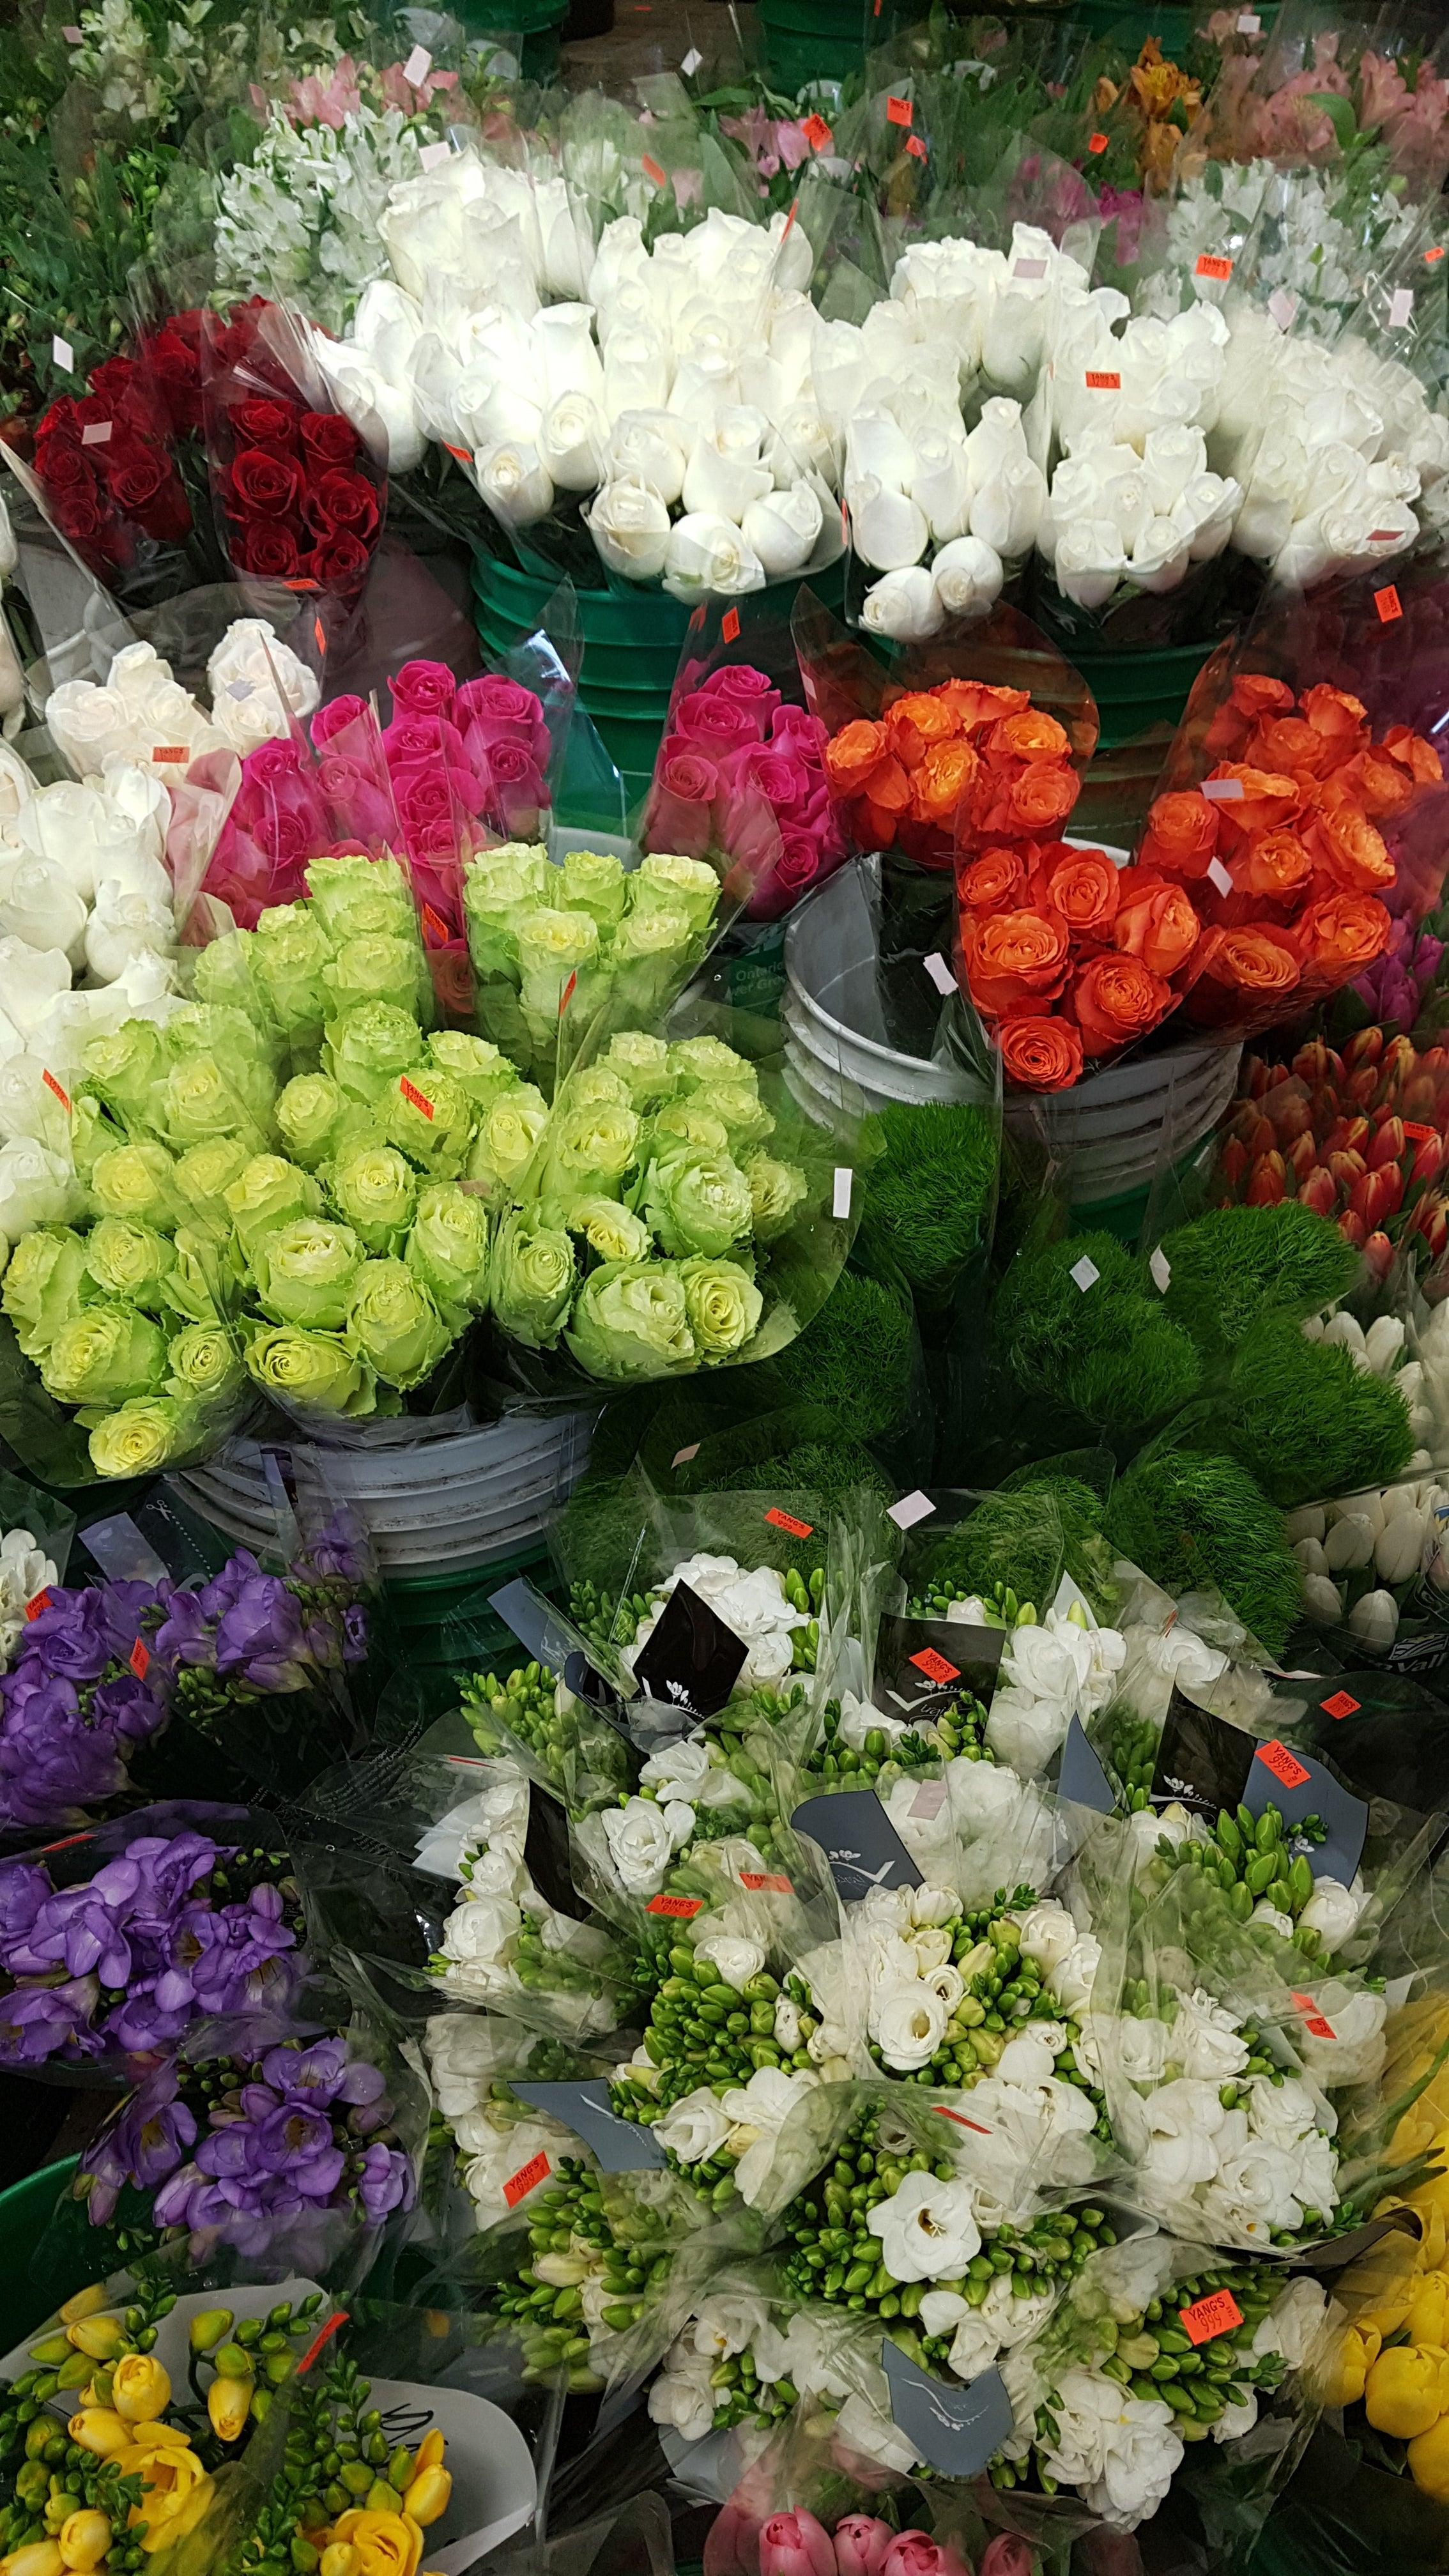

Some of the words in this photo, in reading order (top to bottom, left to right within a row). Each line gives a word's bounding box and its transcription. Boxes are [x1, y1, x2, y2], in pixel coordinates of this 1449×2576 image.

[778, 1512, 806, 1529] YANG'S
[927, 1652, 953, 1674] YANG'S
[1268, 1755, 1289, 1773] 999
[1274, 1745, 1302, 1775] YANG'S
[661, 1897, 695, 1908] YANG'S
[509, 2159, 539, 2189] YANG'S
[1188, 2296, 1225, 2321] YANG'S
[1200, 2312, 1222, 2333] 999
